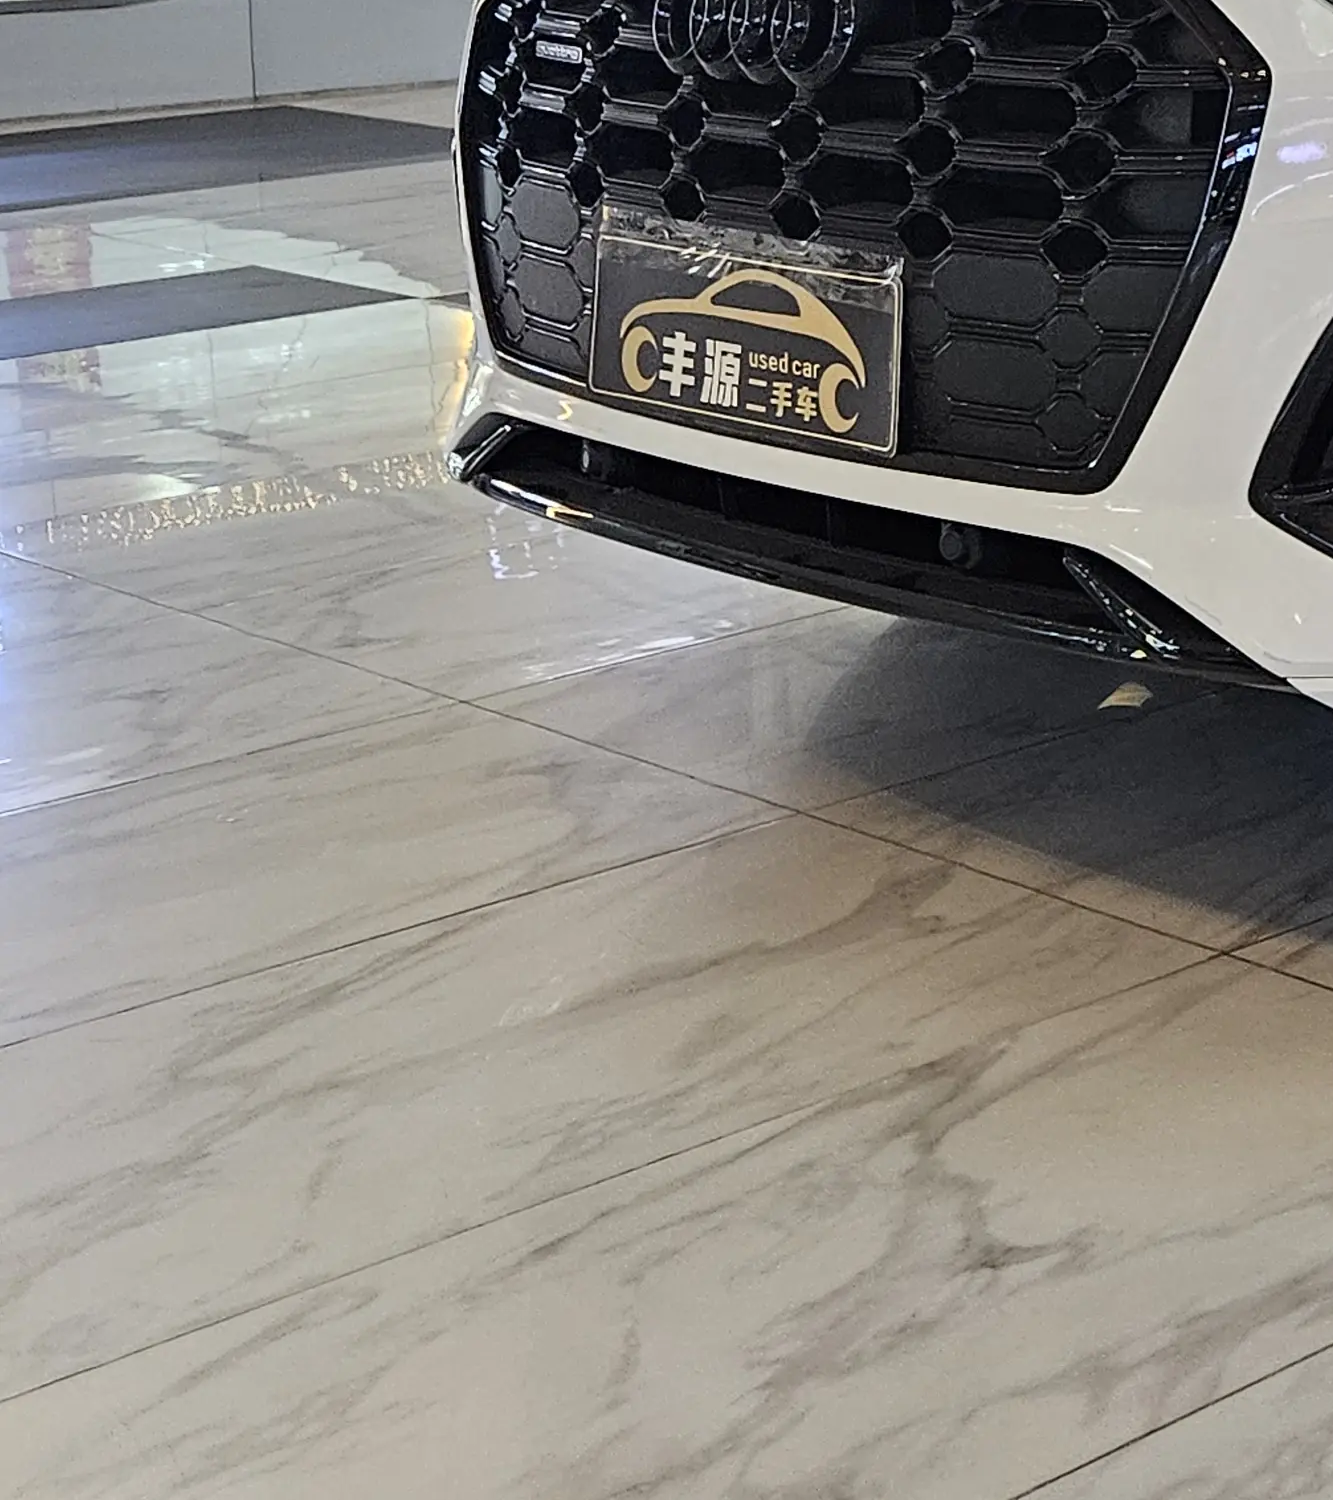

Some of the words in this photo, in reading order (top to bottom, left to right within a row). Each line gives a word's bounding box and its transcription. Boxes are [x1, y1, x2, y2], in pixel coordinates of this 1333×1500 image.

[658, 330, 743, 409] 丰源
[748, 351, 789, 375] used
[791, 361, 821, 380] car
[745, 377, 819, 423] 二手车
